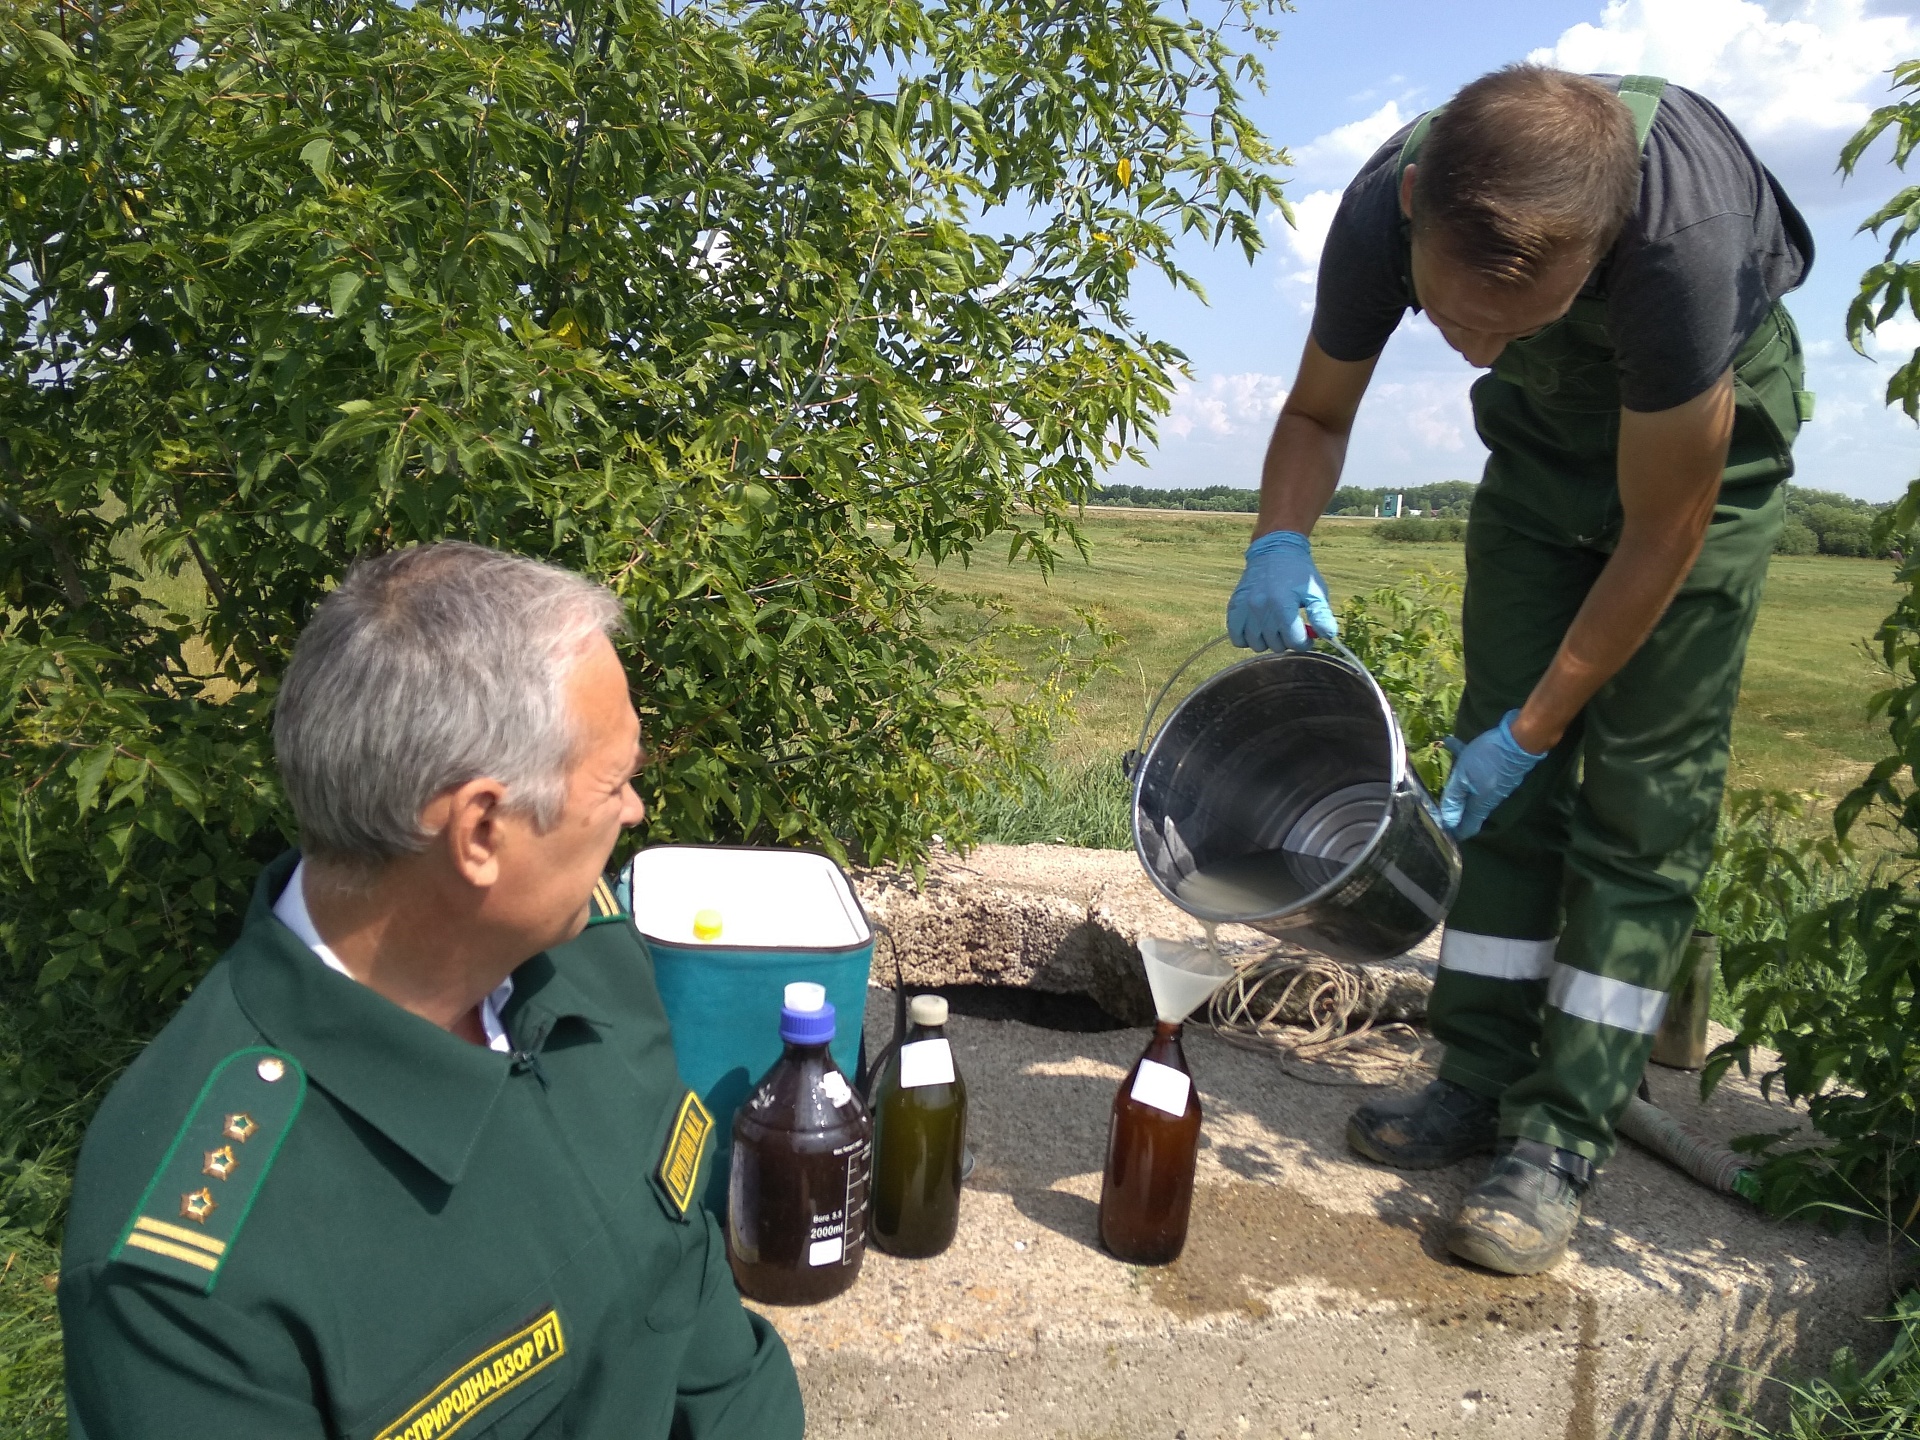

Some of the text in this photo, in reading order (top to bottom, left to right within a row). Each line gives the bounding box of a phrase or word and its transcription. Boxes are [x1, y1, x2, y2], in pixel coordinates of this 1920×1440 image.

[810, 1222, 844, 1239] 2000ml
[385, 1322, 555, 1440] СПРИРОДНАДЗОР РТ
